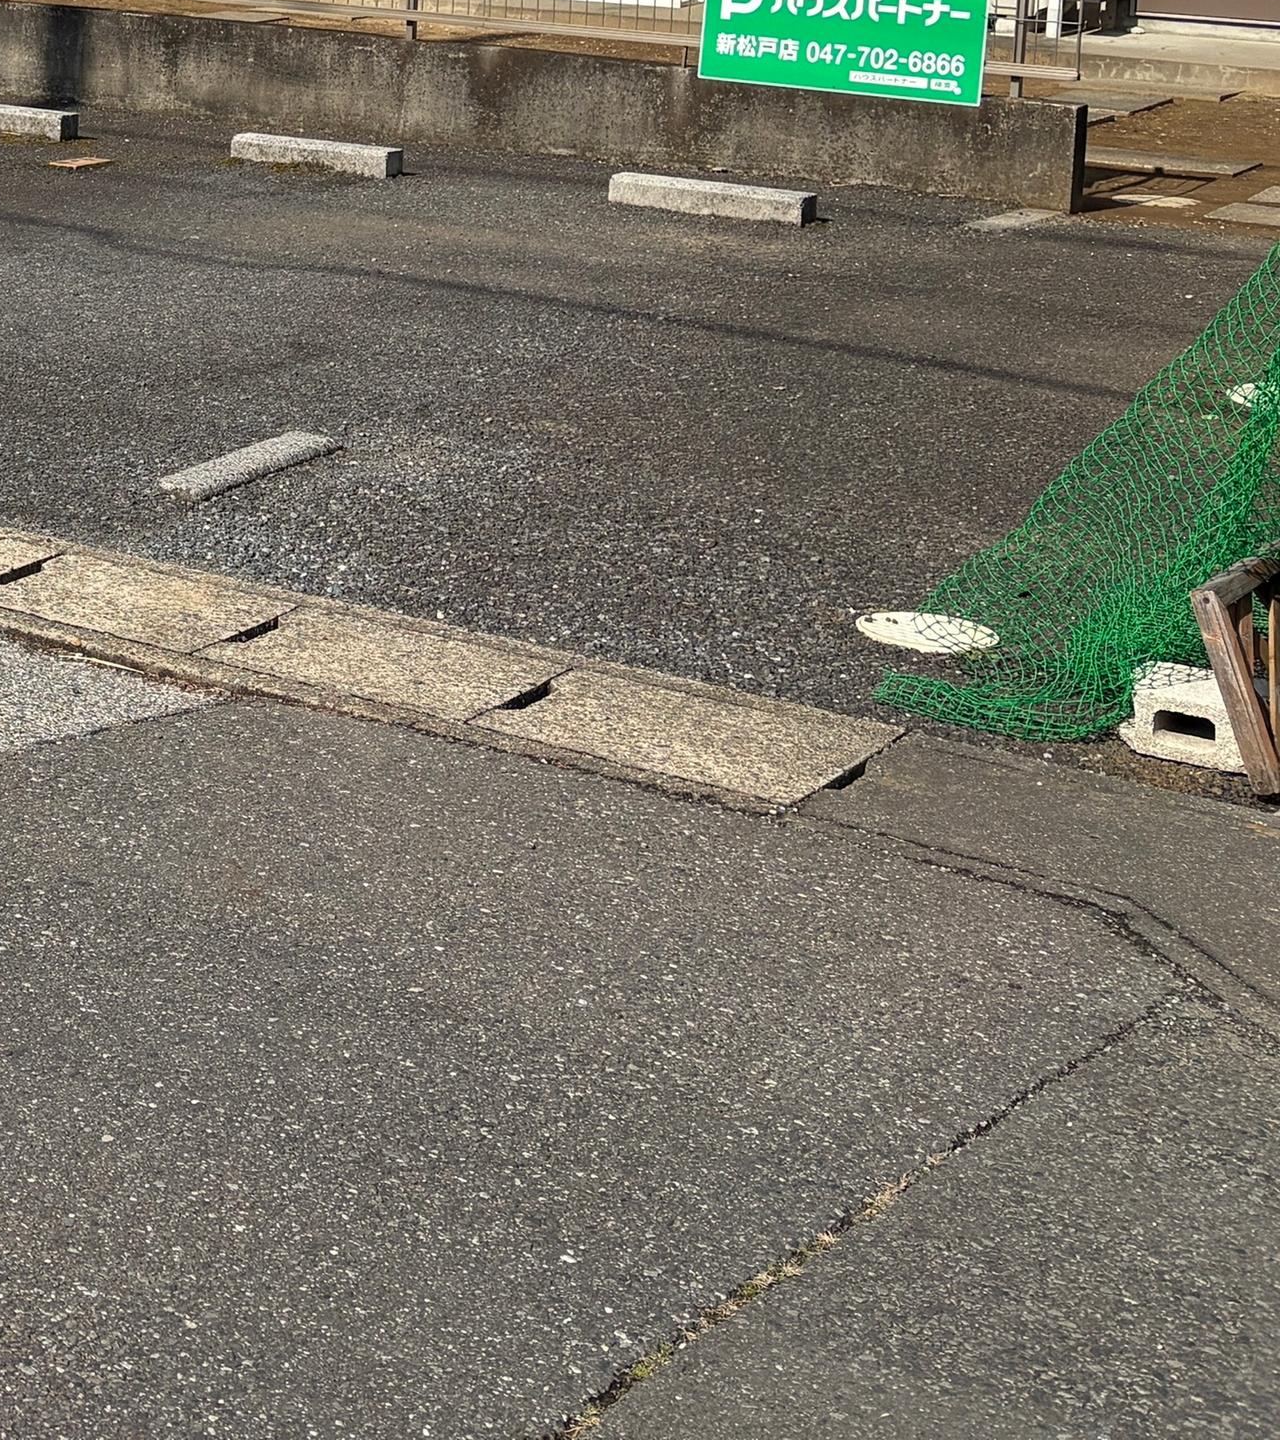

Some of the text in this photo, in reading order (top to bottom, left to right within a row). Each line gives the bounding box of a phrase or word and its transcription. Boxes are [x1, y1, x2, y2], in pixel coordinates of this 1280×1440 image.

[716, 32, 965, 77] 新松戸店 047-702-6866
